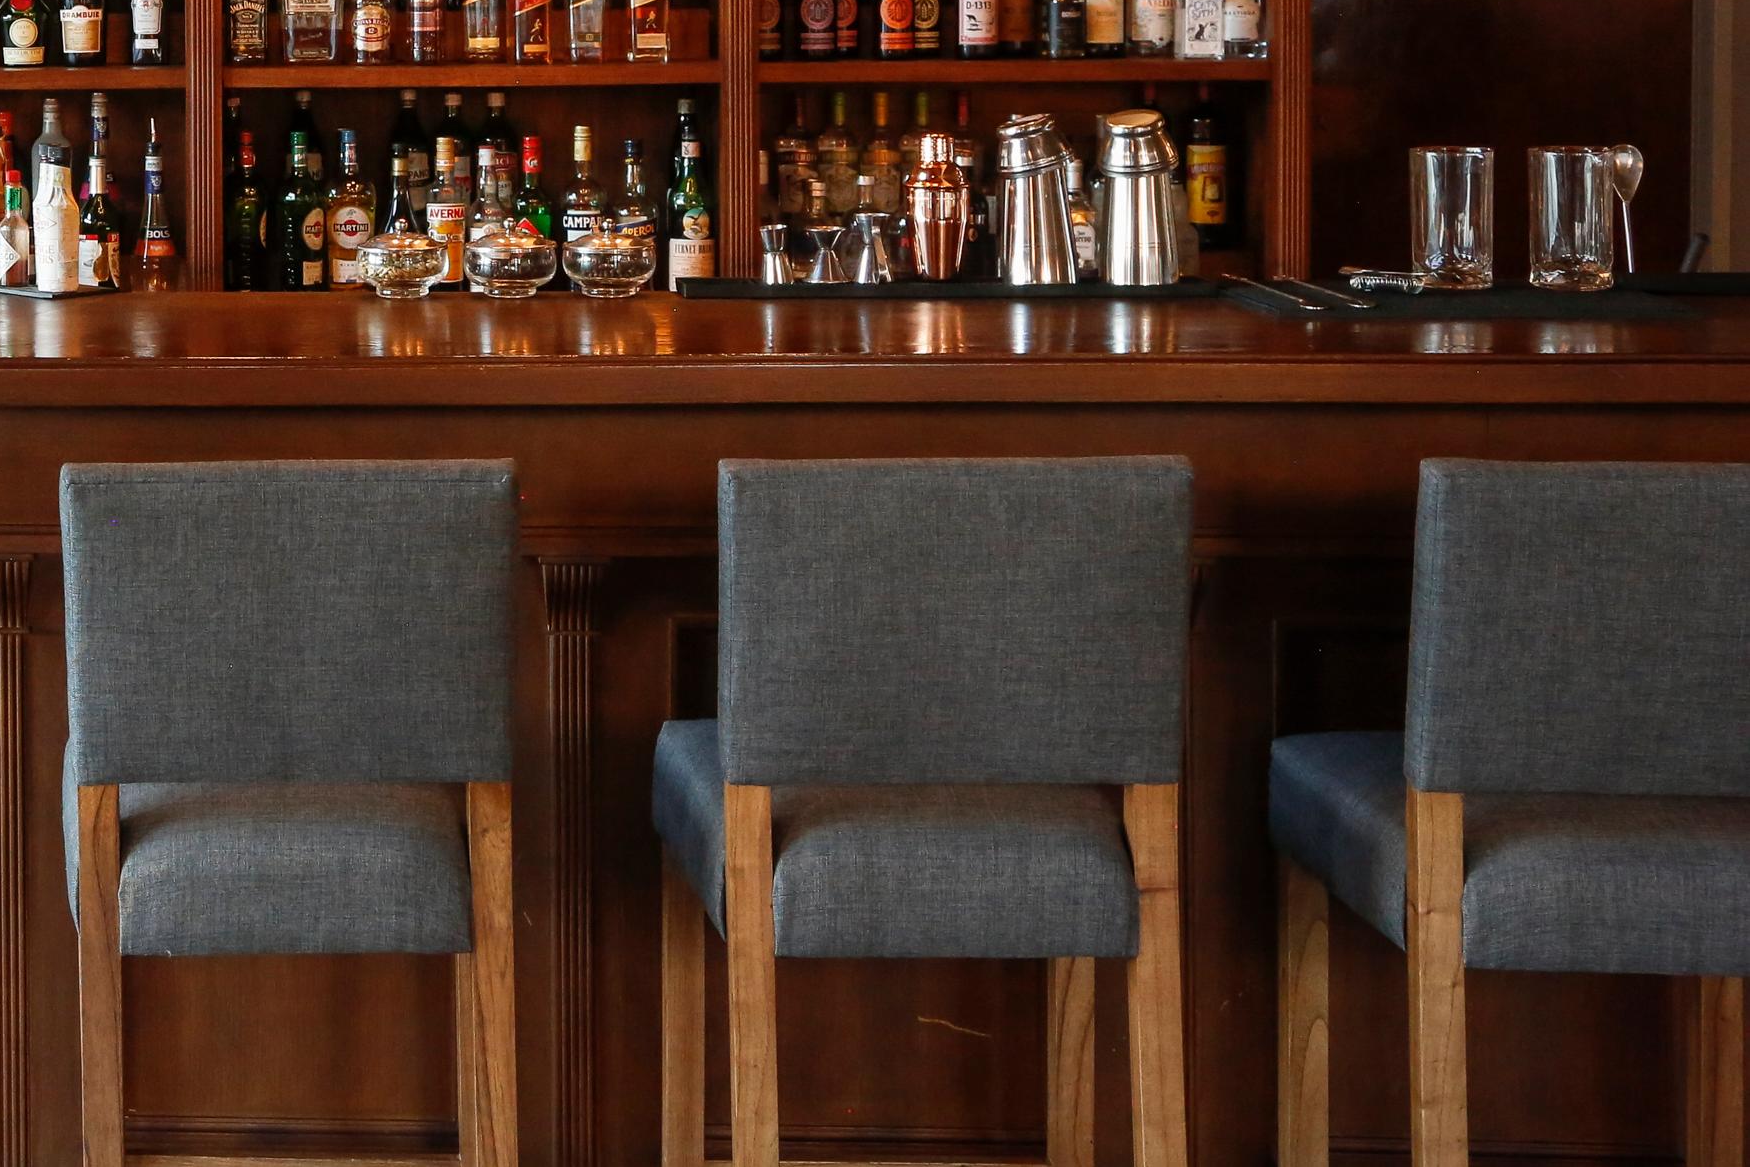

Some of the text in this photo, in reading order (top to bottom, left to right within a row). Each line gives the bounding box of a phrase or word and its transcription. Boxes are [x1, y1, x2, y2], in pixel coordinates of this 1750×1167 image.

[430, 209, 464, 218] AVERNA
[562, 216, 602, 228] CAMPAR
[147, 230, 170, 238] BOLS
